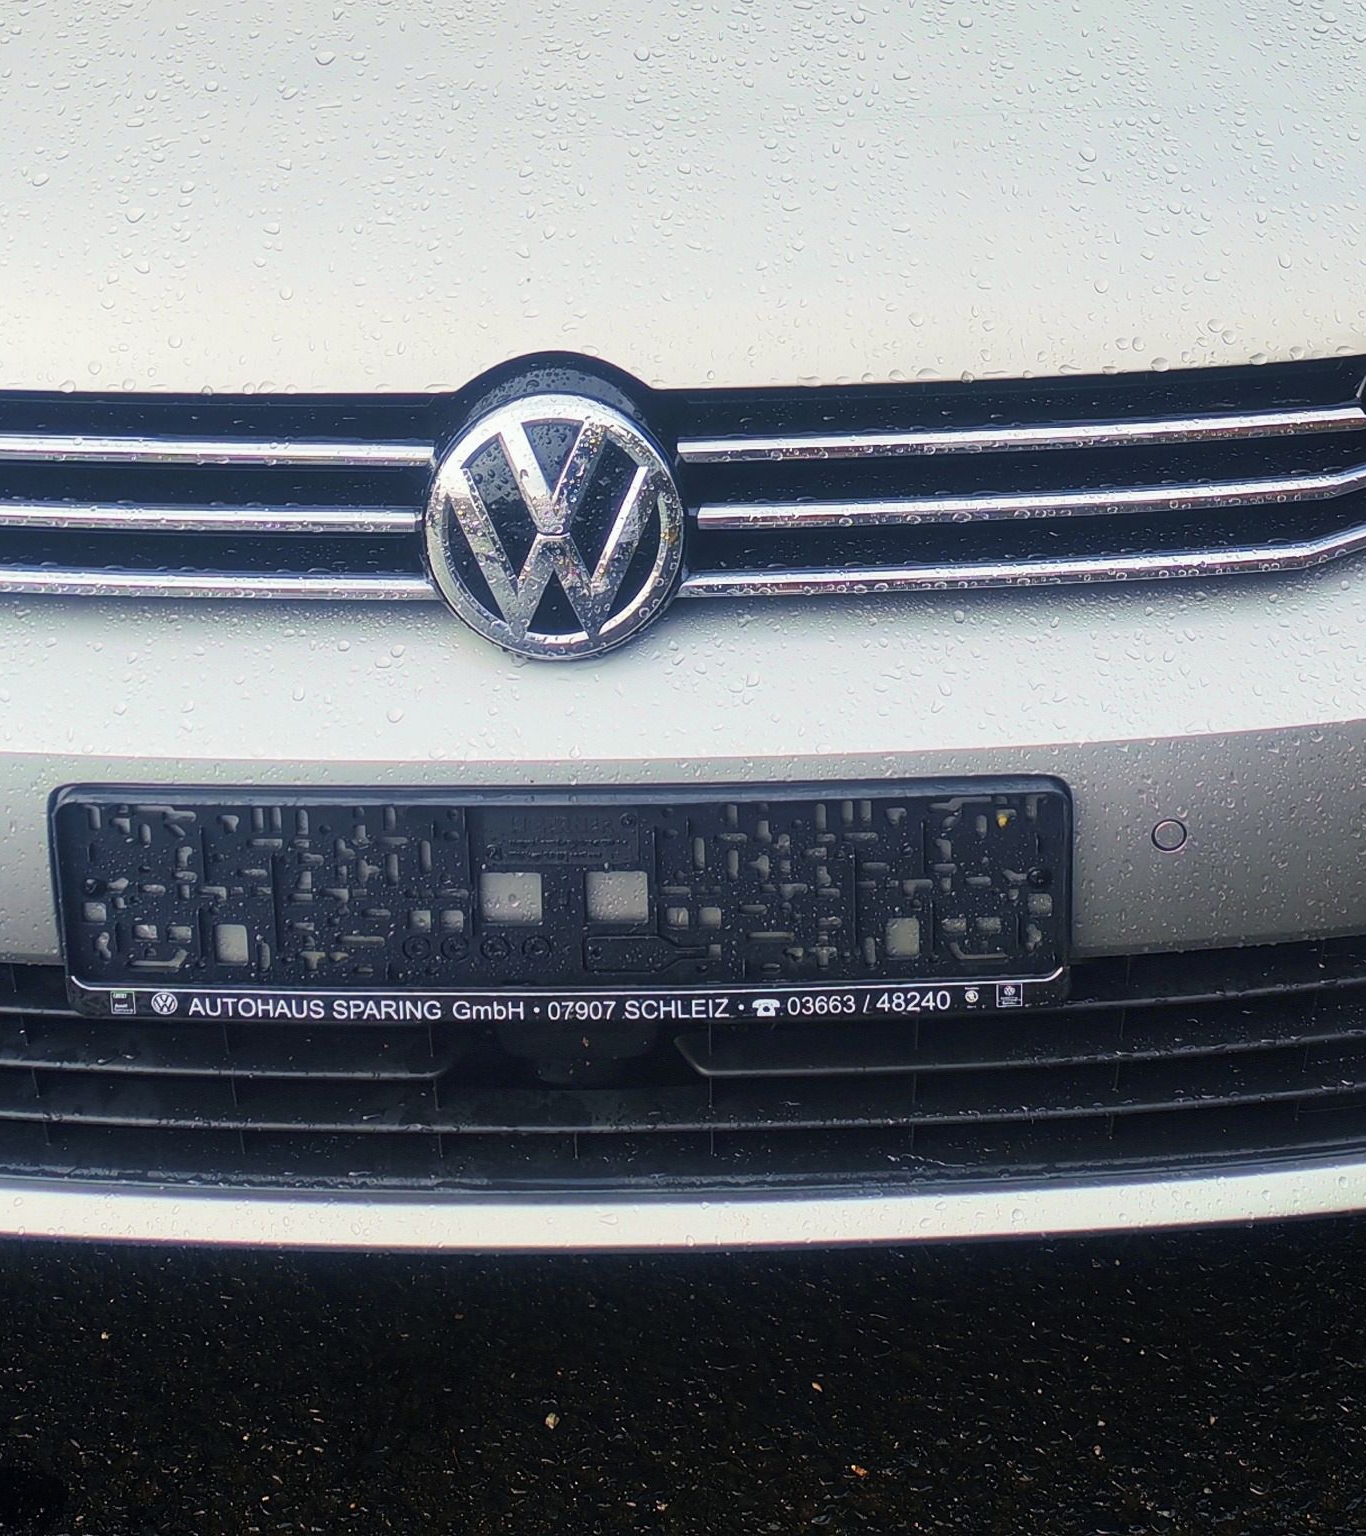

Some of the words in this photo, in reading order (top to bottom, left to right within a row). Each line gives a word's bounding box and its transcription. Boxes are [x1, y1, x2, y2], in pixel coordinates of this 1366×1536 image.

[432, 404, 675, 649] VW
[189, 997, 325, 1019] AUTOHAUS
[332, 1000, 442, 1020] SPARING
[452, 1001, 524, 1020] GmbH
[547, 1000, 616, 1021] 07907
[624, 998, 730, 1020] SCHLEIZ
[787, 995, 856, 1016] 03663
[876, 990, 952, 1013] 48240
